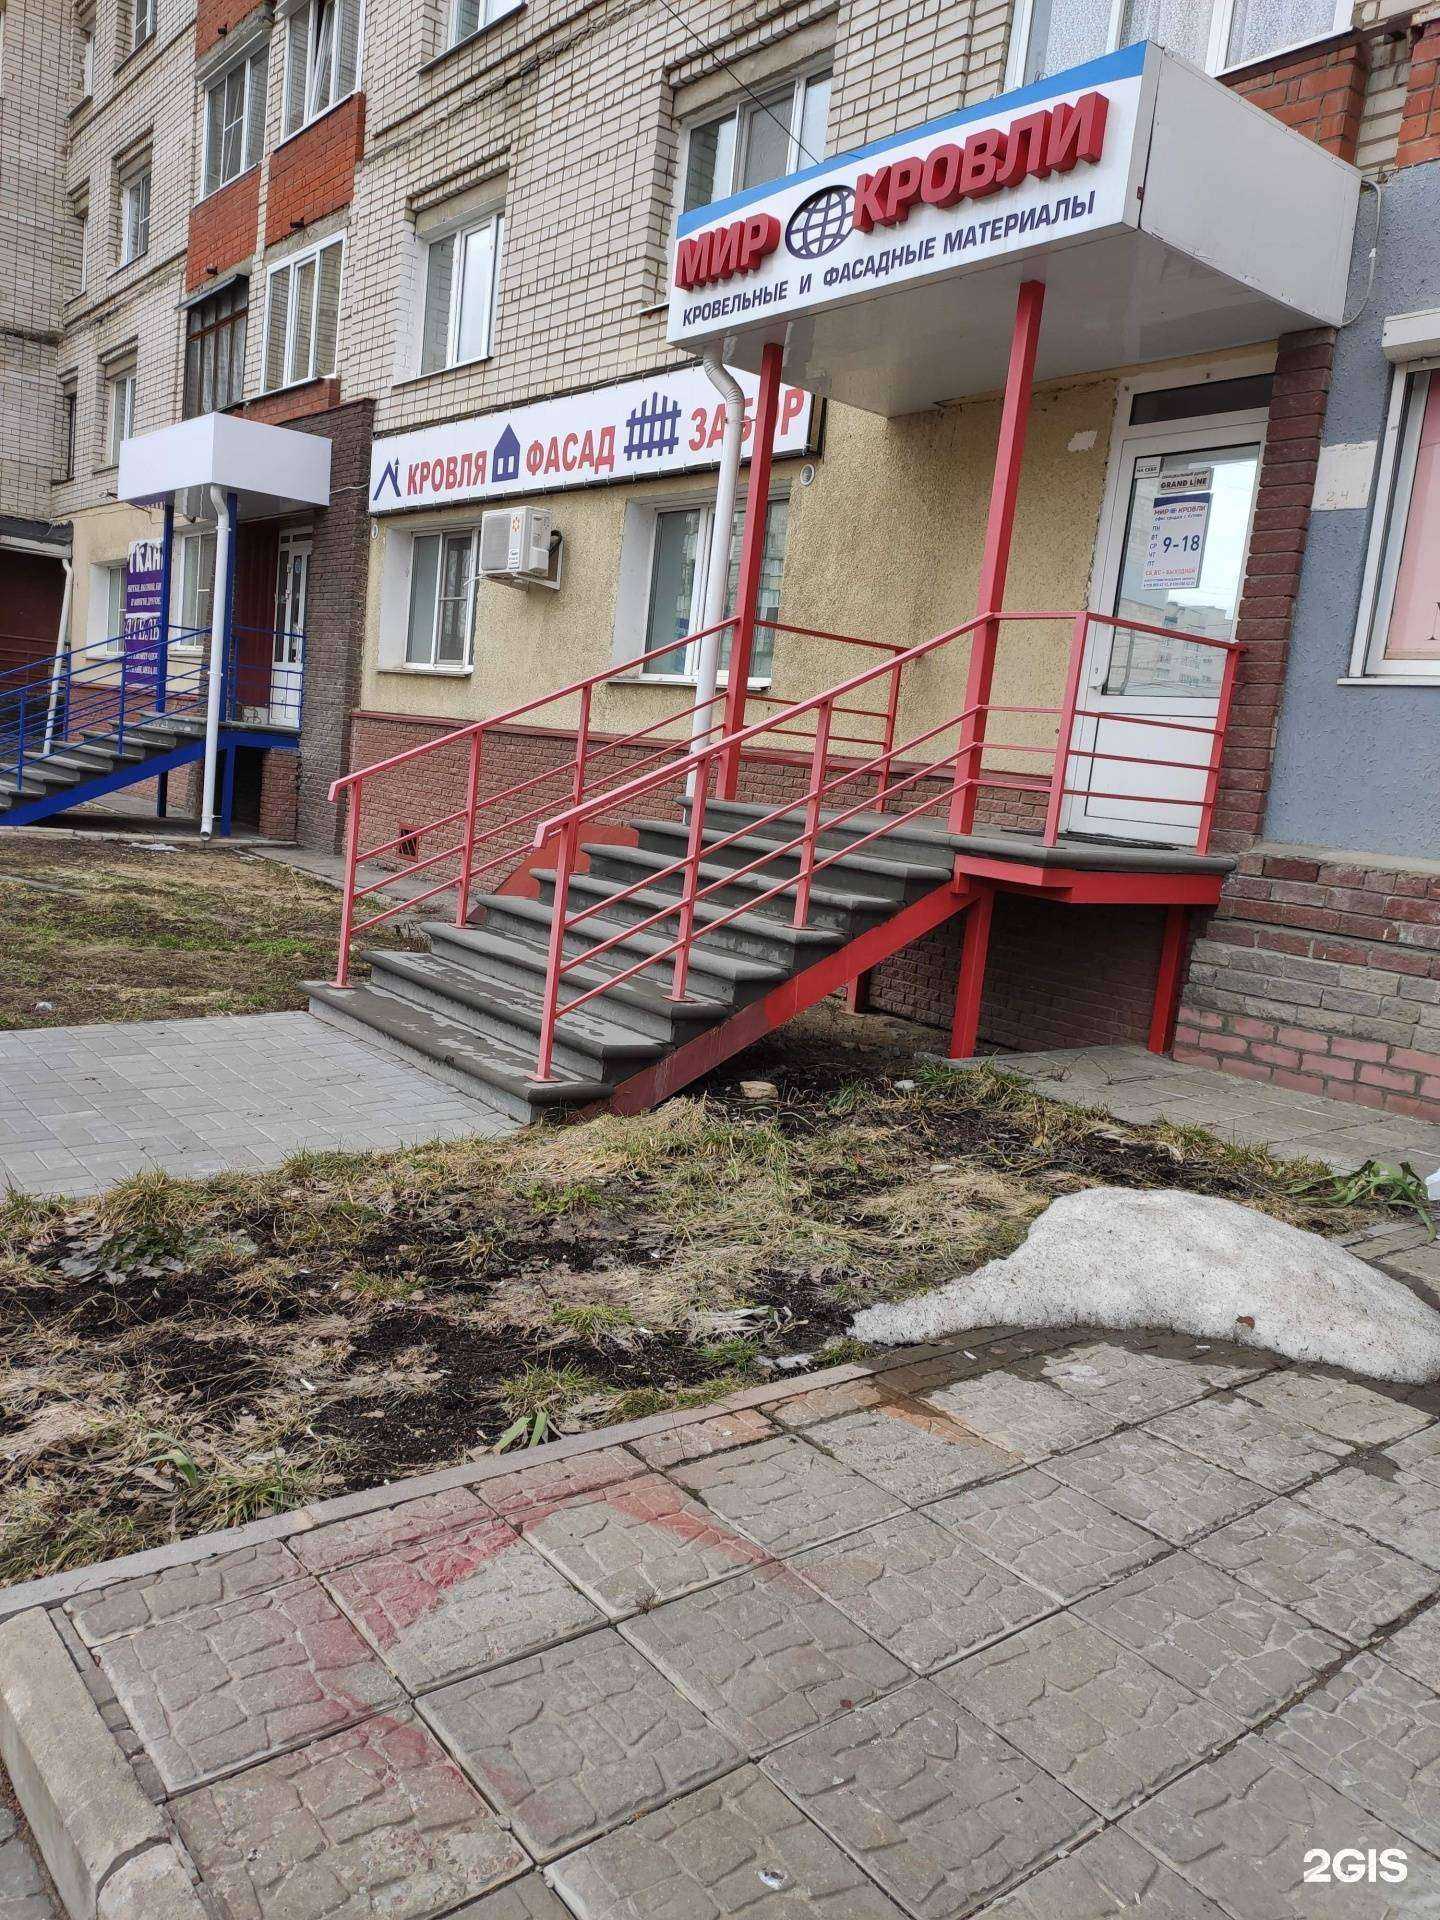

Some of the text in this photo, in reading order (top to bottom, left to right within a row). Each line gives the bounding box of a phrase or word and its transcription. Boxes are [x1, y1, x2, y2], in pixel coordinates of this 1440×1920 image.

[675, 91, 1110, 301] МИР КРОВЛИ
[682, 190, 1096, 326] КРОВЕЛЬНЫЕ И ФАСАДНЫЕ МАТЕРИАЛЫ
[407, 388, 805, 496] КРОВЛЯ ФАСАД ЗАБР
[1160, 480, 1188, 489] GRAND
[1163, 534, 1200, 554] 9-18
